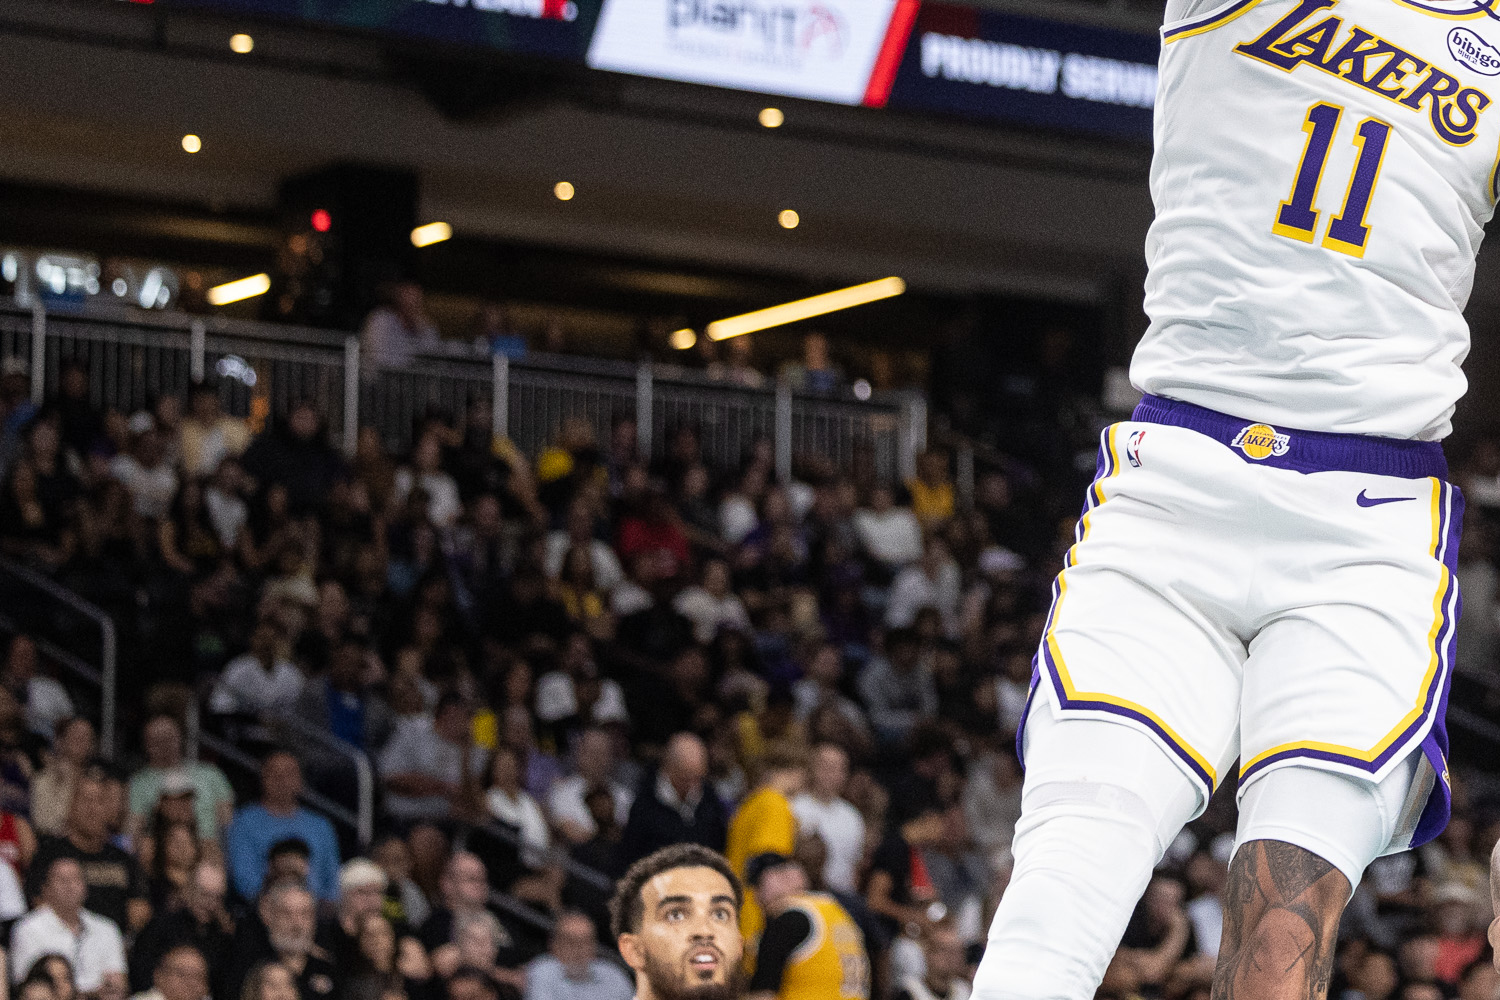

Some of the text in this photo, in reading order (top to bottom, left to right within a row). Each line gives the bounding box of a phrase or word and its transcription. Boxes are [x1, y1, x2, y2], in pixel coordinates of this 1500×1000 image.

[921, 32, 1061, 94] PROUDLY
[1452, 31, 1500, 69] bibigo
[1457, 47, 1478, 66] 비비고
[1272, 101, 1393, 259] 11
[1235, 429, 1288, 454] LAKERS
